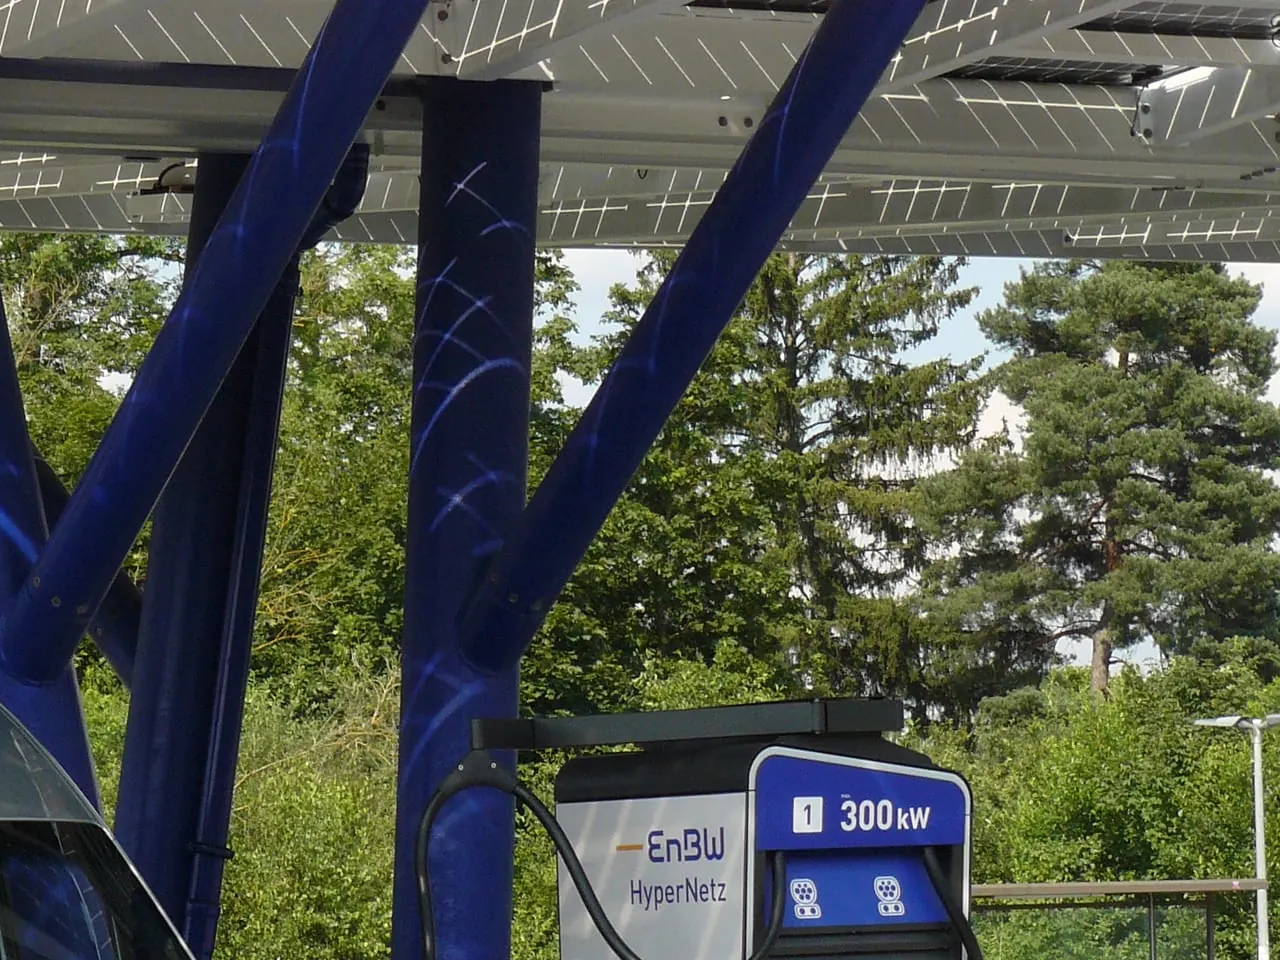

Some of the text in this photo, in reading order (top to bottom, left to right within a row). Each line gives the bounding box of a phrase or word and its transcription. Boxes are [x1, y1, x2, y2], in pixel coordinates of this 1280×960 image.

[803, 799, 931, 832] 1 300 kW
[647, 826, 725, 863] EnBW
[630, 876, 727, 911] HyperNetz
